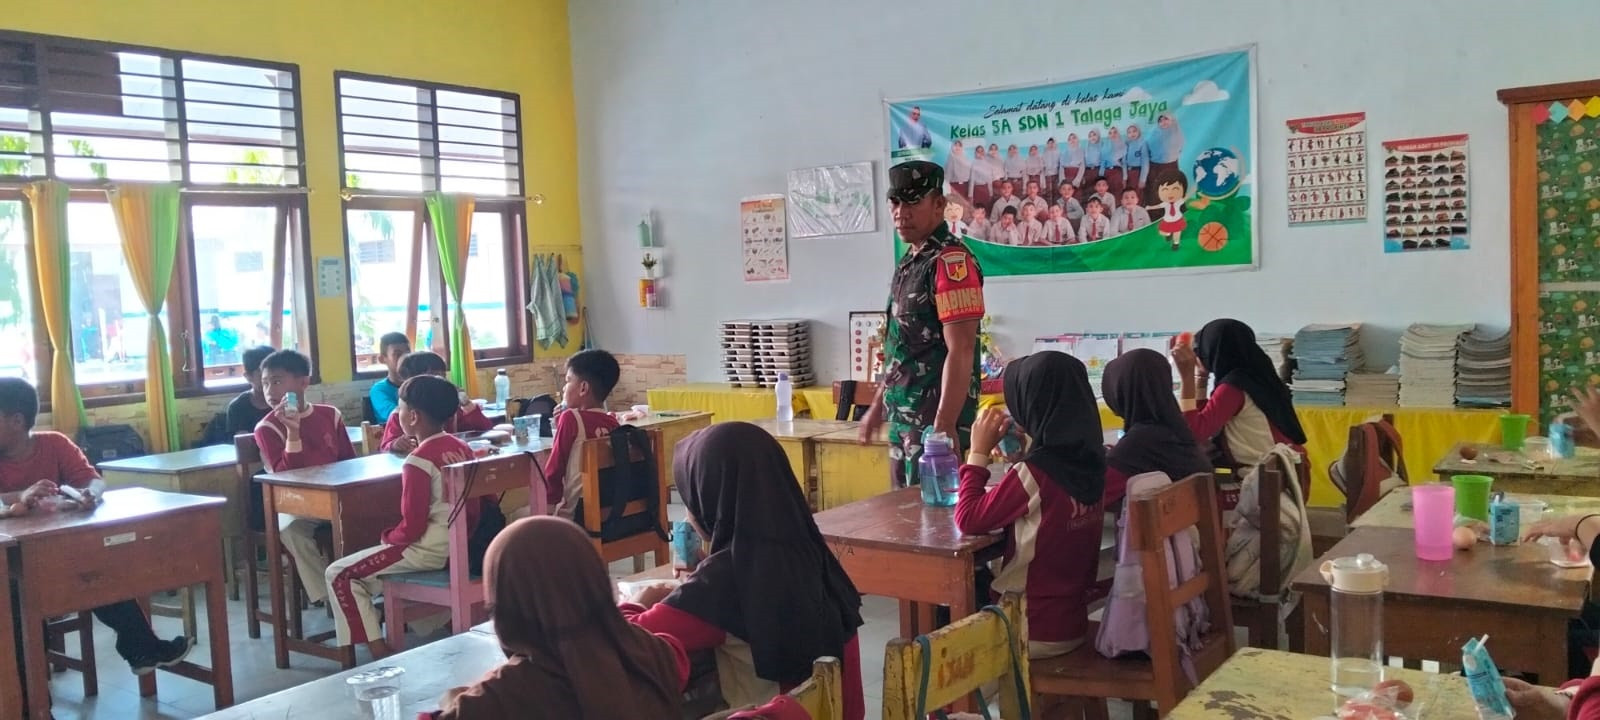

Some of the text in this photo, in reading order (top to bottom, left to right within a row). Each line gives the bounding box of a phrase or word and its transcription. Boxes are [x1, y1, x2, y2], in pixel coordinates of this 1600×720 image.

[950, 100, 1168, 139] Kelas 5A SDN 1 Talaga Jaya
[984, 102, 1022, 119] Selamat
[1026, 99, 1056, 113] datang
[1060, 96, 1071, 107] di
[1075, 94, 1098, 105] kelas
